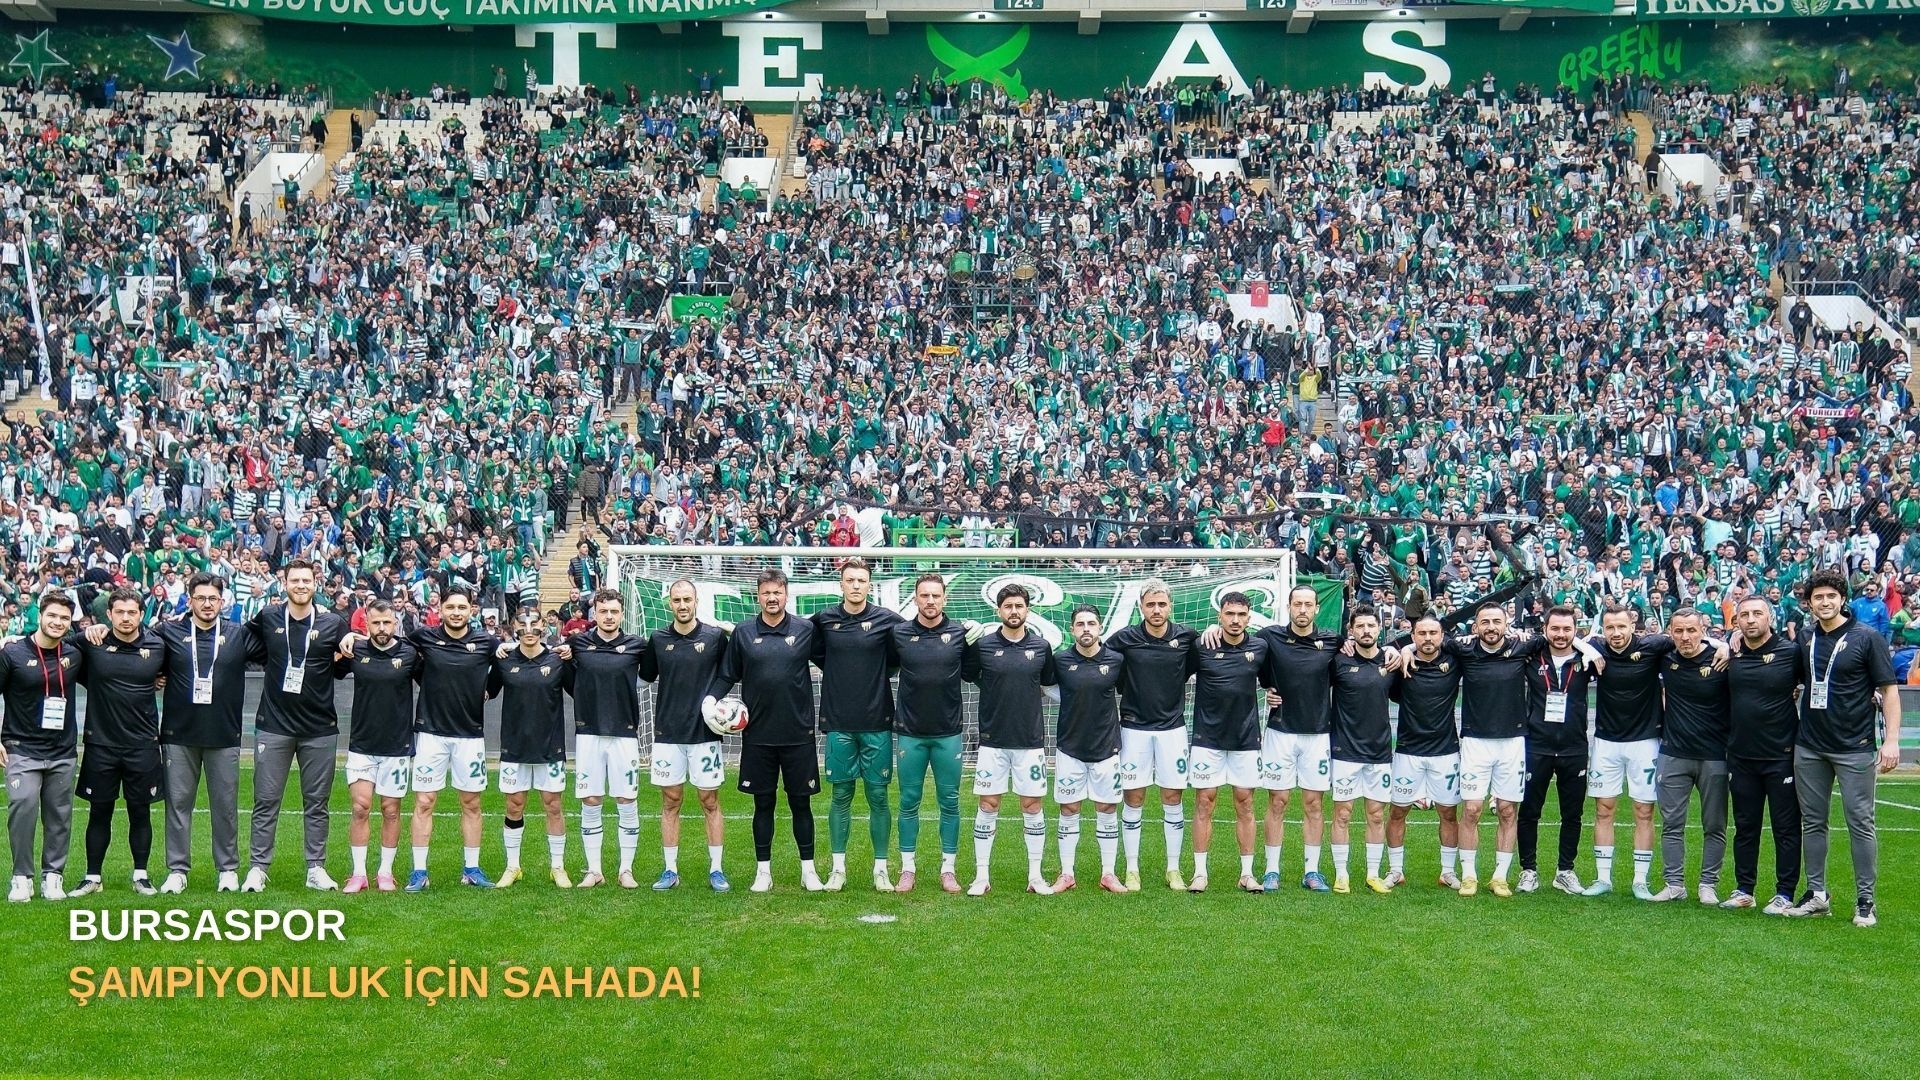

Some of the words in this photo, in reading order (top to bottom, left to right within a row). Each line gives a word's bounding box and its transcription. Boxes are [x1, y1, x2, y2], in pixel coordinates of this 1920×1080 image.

[701, 754, 721, 773] 24
[391, 767, 408, 785] 11
[1394, 786, 1413, 795] Togg
